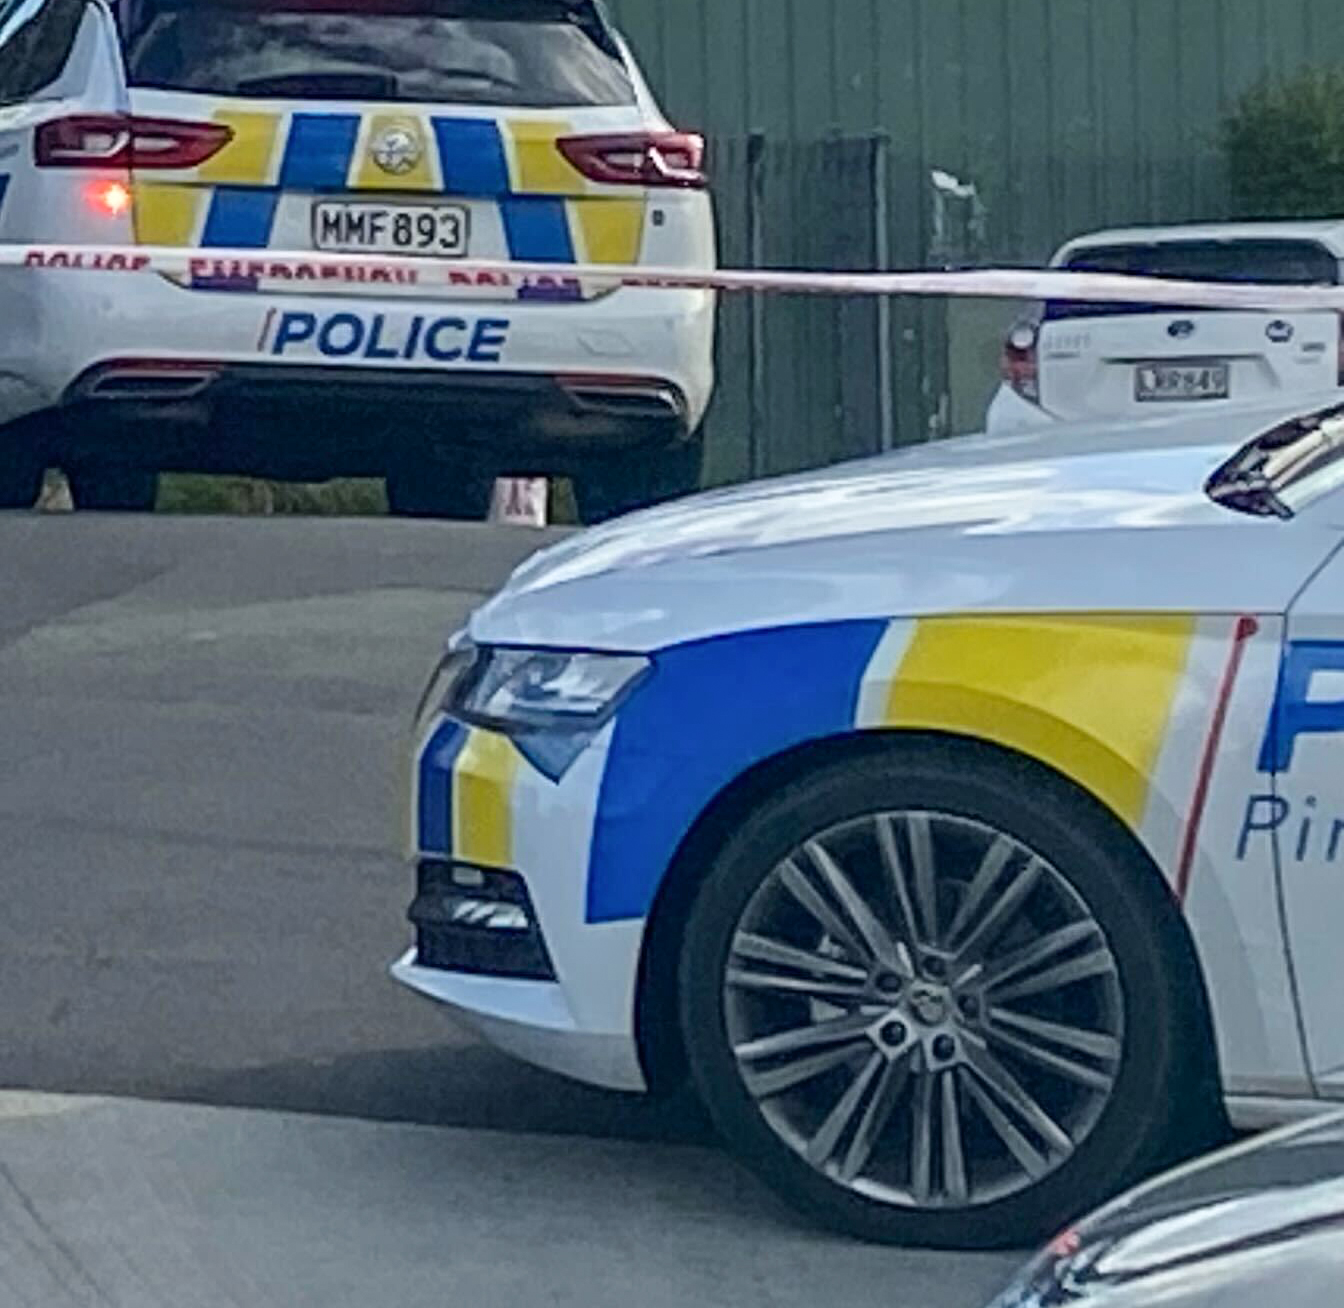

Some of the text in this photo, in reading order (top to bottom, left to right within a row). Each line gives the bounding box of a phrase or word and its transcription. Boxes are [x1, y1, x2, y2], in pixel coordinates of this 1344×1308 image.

[320, 209, 460, 249] MMF893
[272, 311, 510, 362] POLICE
[1256, 639, 1344, 774] P
